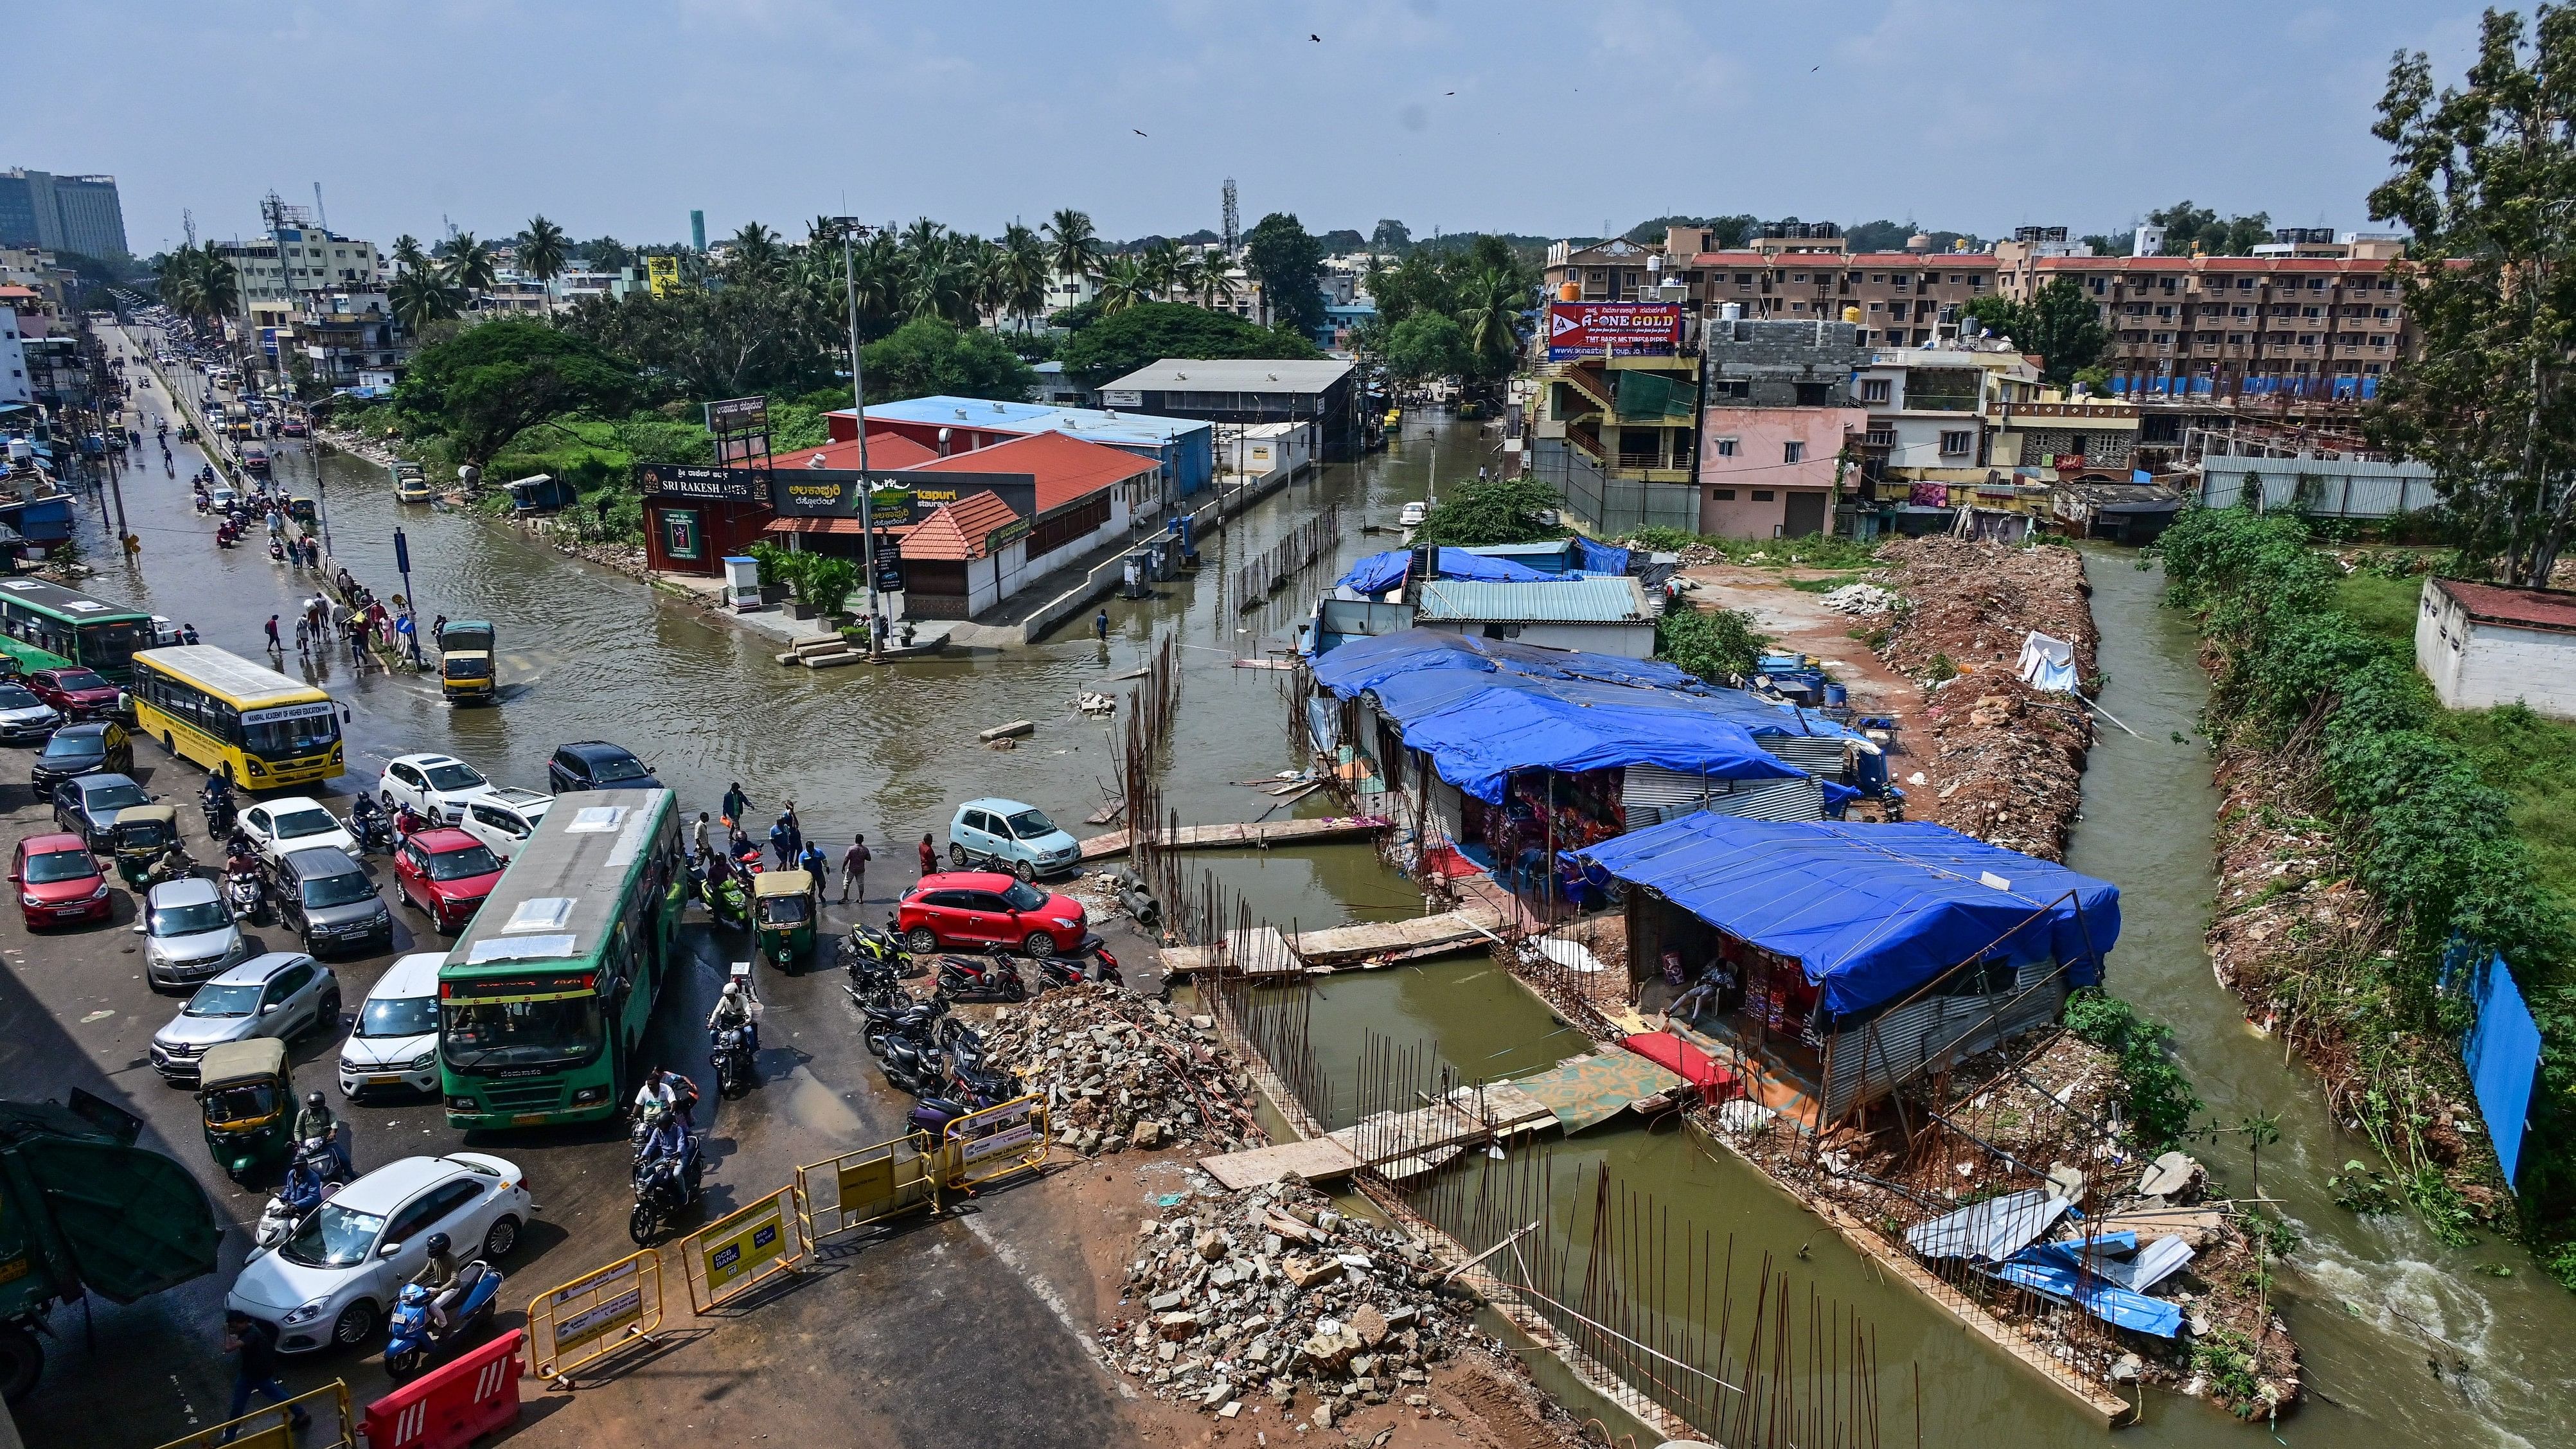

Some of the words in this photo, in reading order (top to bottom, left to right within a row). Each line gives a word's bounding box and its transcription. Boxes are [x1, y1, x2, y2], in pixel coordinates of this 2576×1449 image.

[1582, 314, 1630, 327] A-ONE
[1632, 316, 1673, 326] GOLD
[662, 481, 679, 491] SRI
[680, 481, 720, 493] RAKESH
[788, 484, 840, 499] ಅಲಕಾಪುರಿ
[917, 489, 957, 501] kapuri
[248, 713, 265, 722] MANIPAL
[265, 711, 283, 720] ACADEMY
[303, 706, 321, 715] EDUCATION
[981, 1109, 1002, 1119] BENGALURU
[992, 1111, 1013, 1120] YELAHANKA
[1013, 1142, 1030, 1151] Matters
[715, 1249, 732, 1261] DCB
[716, 1252, 738, 1268] BANK
